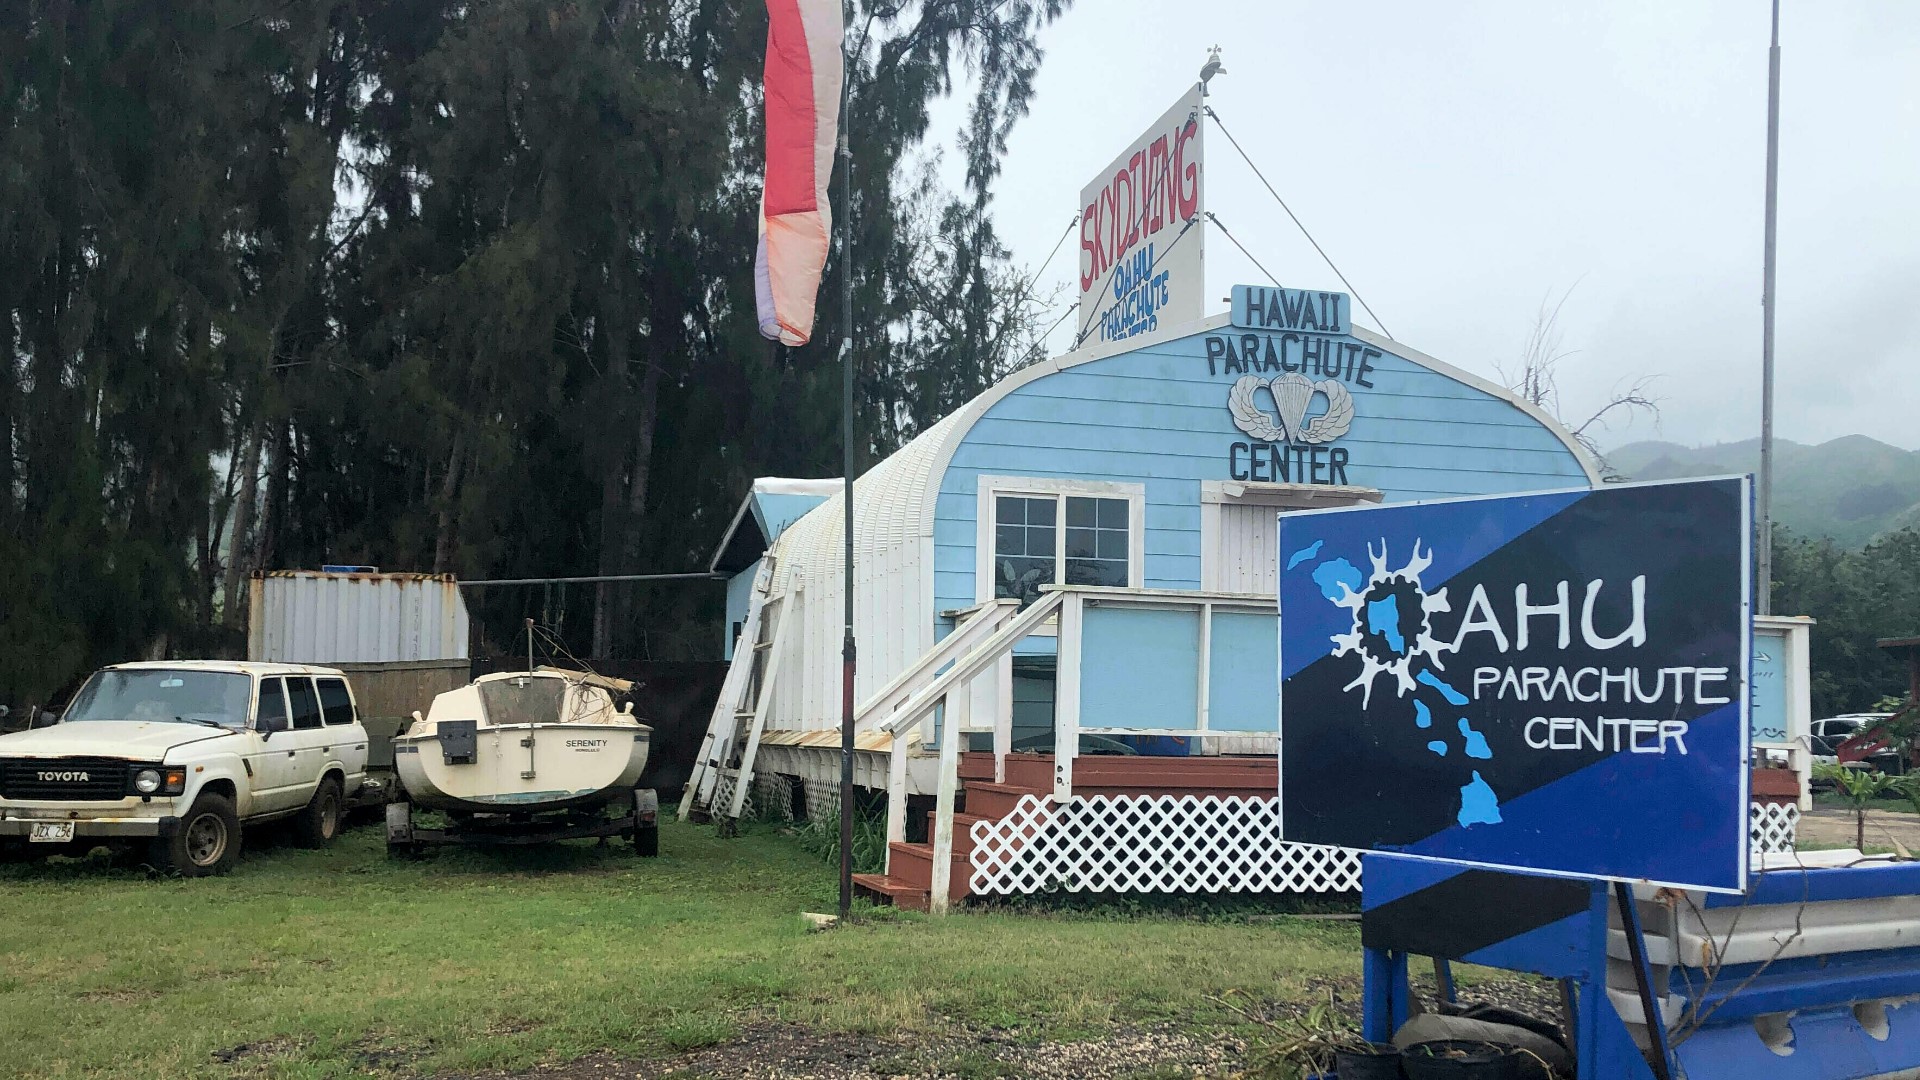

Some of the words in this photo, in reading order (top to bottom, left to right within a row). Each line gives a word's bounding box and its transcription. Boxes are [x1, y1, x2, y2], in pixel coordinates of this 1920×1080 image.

[1081, 121, 1198, 292] SKYDIVING
[1114, 242, 1154, 300] OAHU
[1101, 269, 1169, 342] PARACHUTE
[1245, 286, 1341, 332] HAWAII
[1205, 332, 1383, 389] PARACHUTE
[1229, 441, 1349, 486] CENTER
[1473, 665, 1731, 705] PARACHUTE
[565, 739, 608, 748] SERENITY
[1523, 715, 1689, 756] CENTER
[37, 771, 89, 782] TOYOTA
